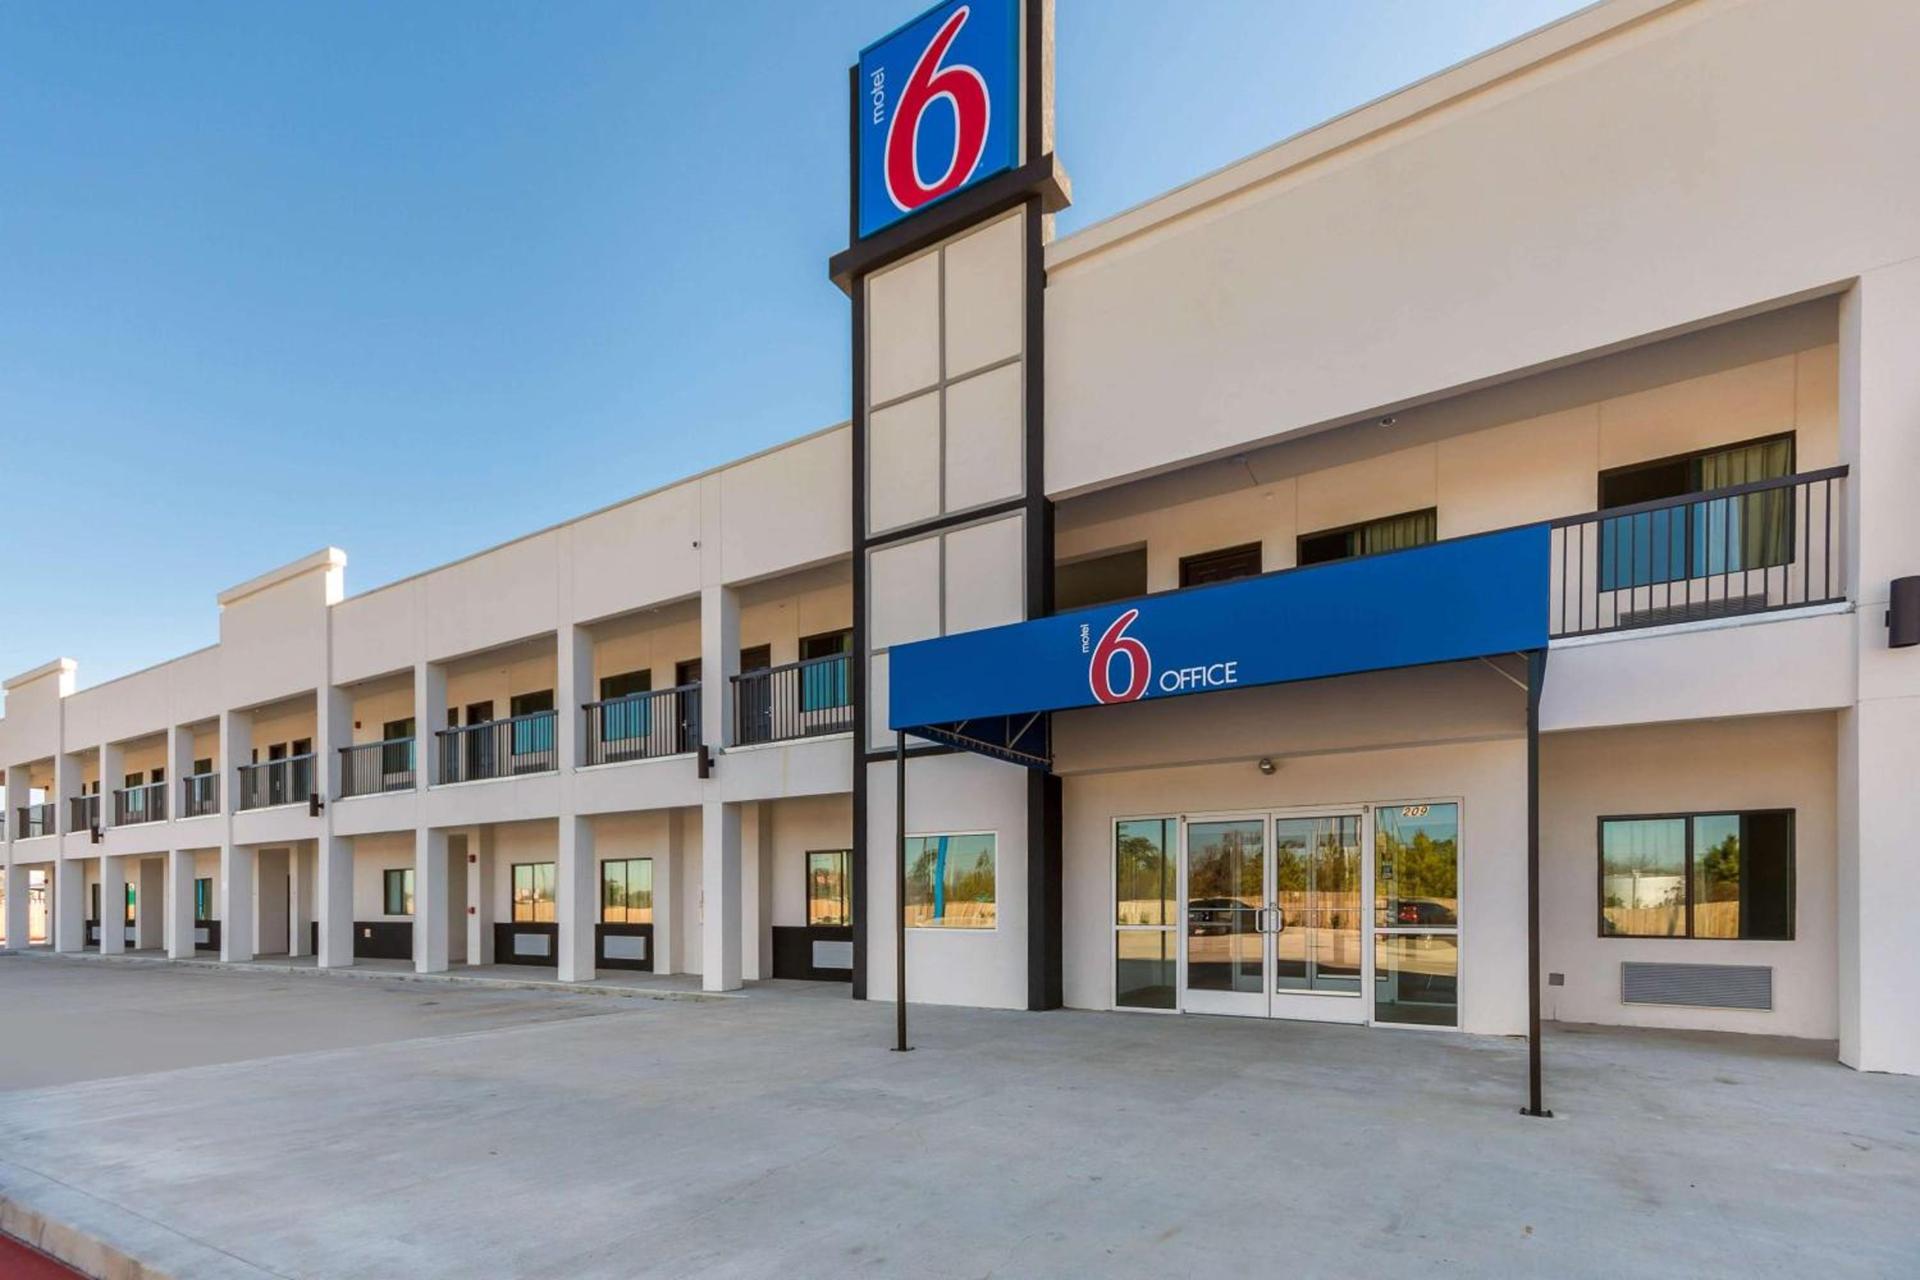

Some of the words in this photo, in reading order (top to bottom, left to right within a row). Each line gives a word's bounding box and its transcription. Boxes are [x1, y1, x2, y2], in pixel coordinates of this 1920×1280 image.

[870, 66, 885, 125] motel
[884, 5, 991, 213] 6
[1080, 623, 1090, 654] motel
[1089, 608, 1151, 704] 6
[1159, 661, 1238, 692] OFFICE
[1402, 806, 1429, 817] 209
